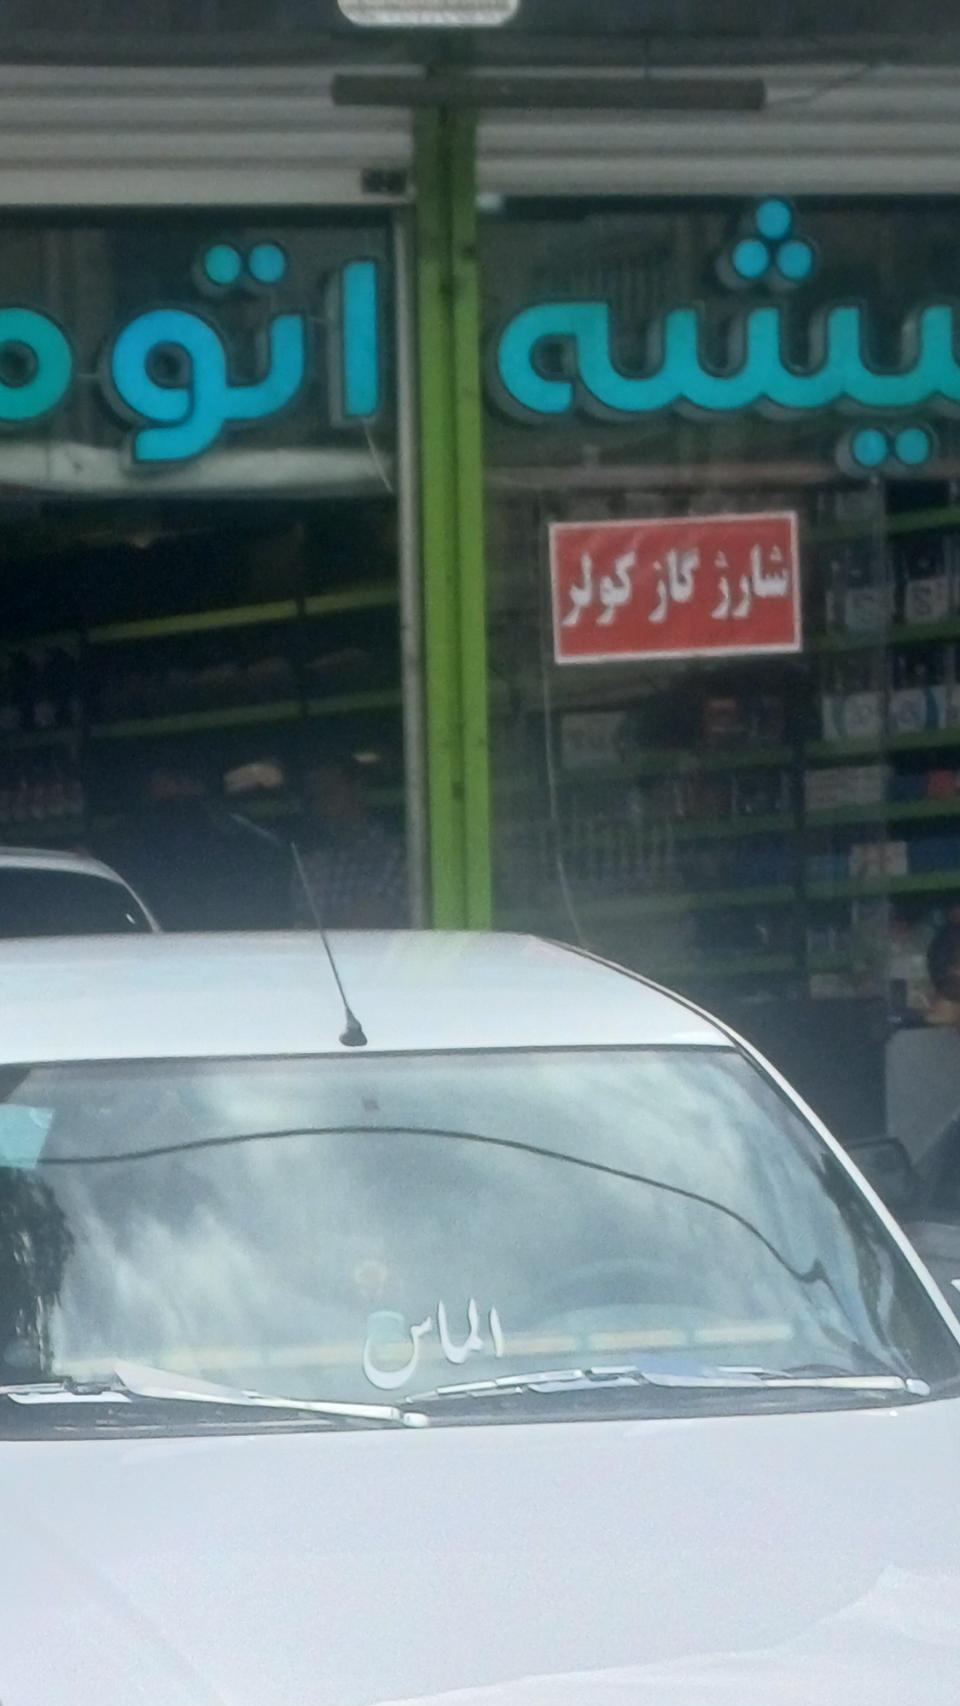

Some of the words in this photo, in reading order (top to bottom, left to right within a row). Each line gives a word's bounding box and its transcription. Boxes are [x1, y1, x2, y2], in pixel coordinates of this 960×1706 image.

[497, 199, 960, 468] یشه
[562, 551, 637, 628] کولر
[648, 548, 700, 624] گاز
[711, 545, 789, 620] شارژ
[363, 1297, 504, 1390] الماس
